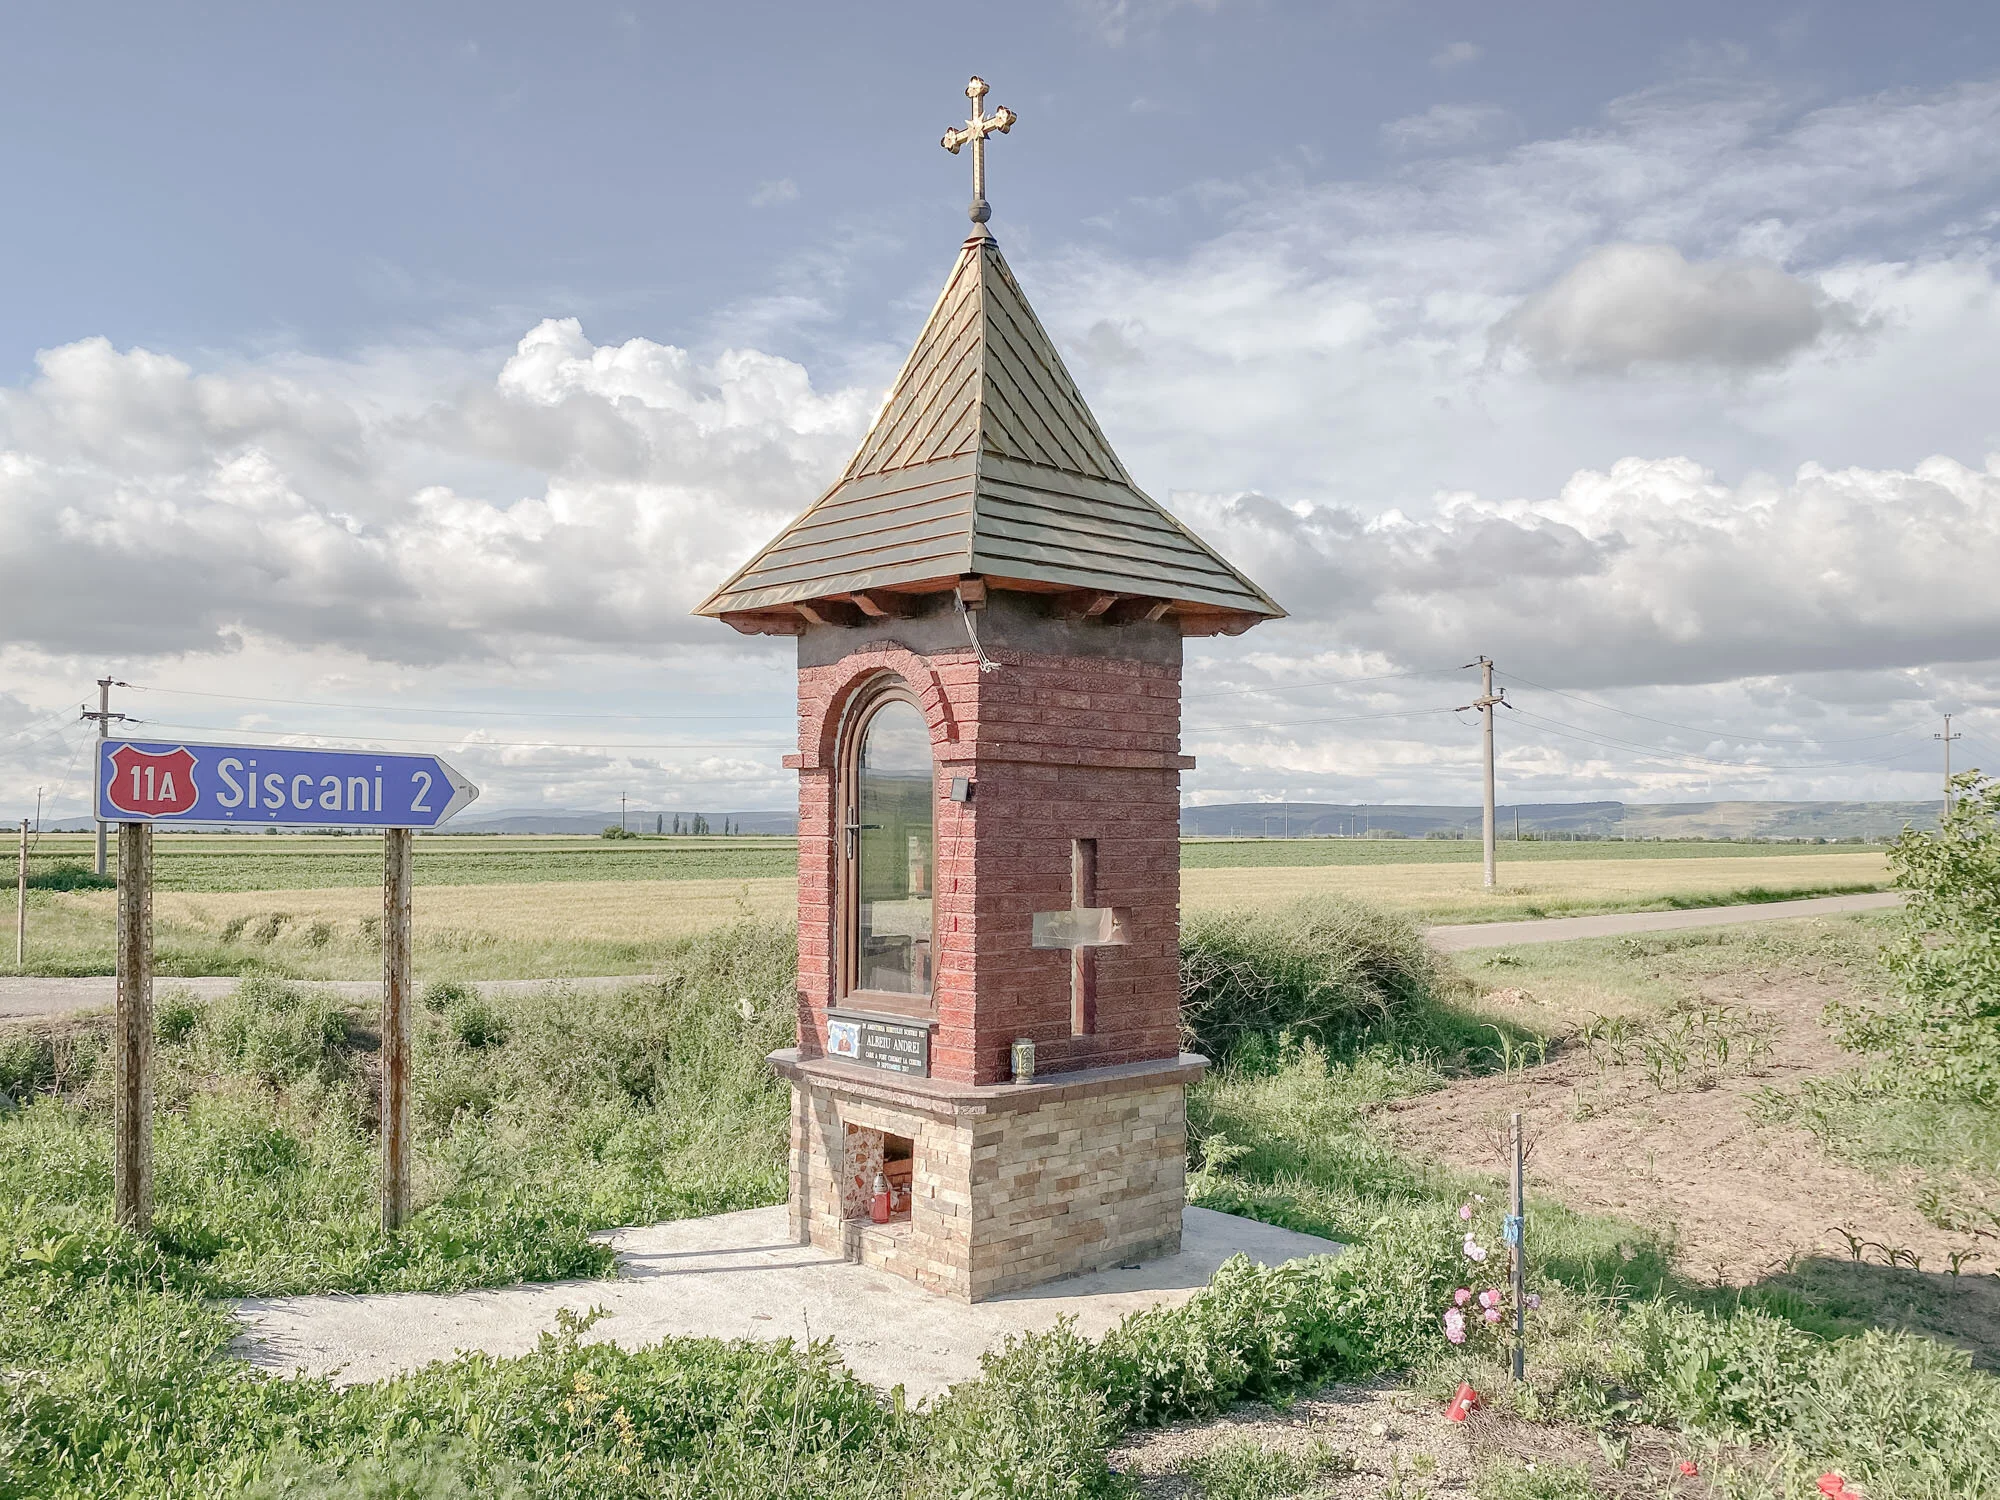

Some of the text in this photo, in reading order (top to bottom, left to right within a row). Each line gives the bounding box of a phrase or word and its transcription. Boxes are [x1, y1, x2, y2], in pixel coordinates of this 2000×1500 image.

[129, 757, 433, 819] 11A Șișcani 2
[893, 1039, 920, 1054] ANDREI
